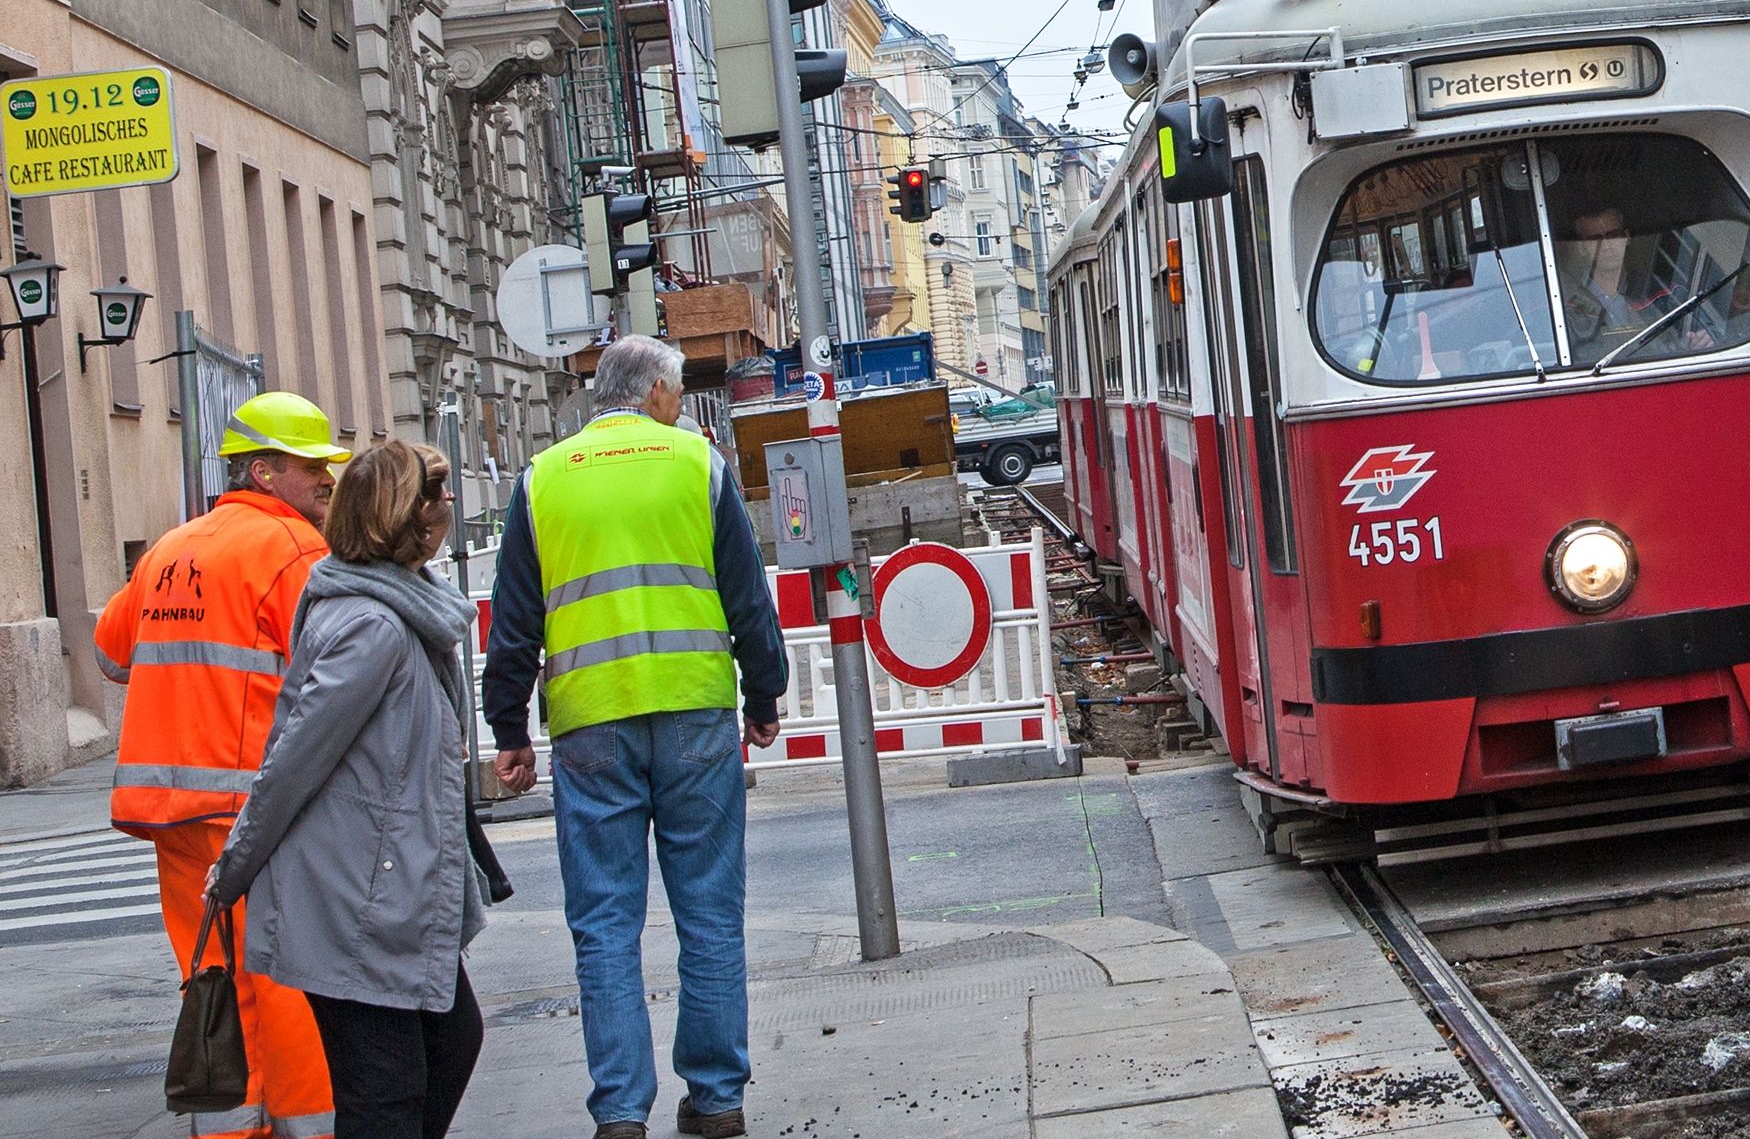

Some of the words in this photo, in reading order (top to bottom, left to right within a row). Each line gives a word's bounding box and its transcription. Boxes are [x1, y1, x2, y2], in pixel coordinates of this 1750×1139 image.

[47, 84, 123, 115] 19.12
[1428, 68, 1571, 99] Praterstern
[25, 117, 148, 150] MONGOLISCHES
[10, 161, 54, 185] CAFE
[59, 149, 167, 180] RESTAURANT
[638, 445, 670, 453] LINIEN
[1349, 515, 1444, 567] 4551
